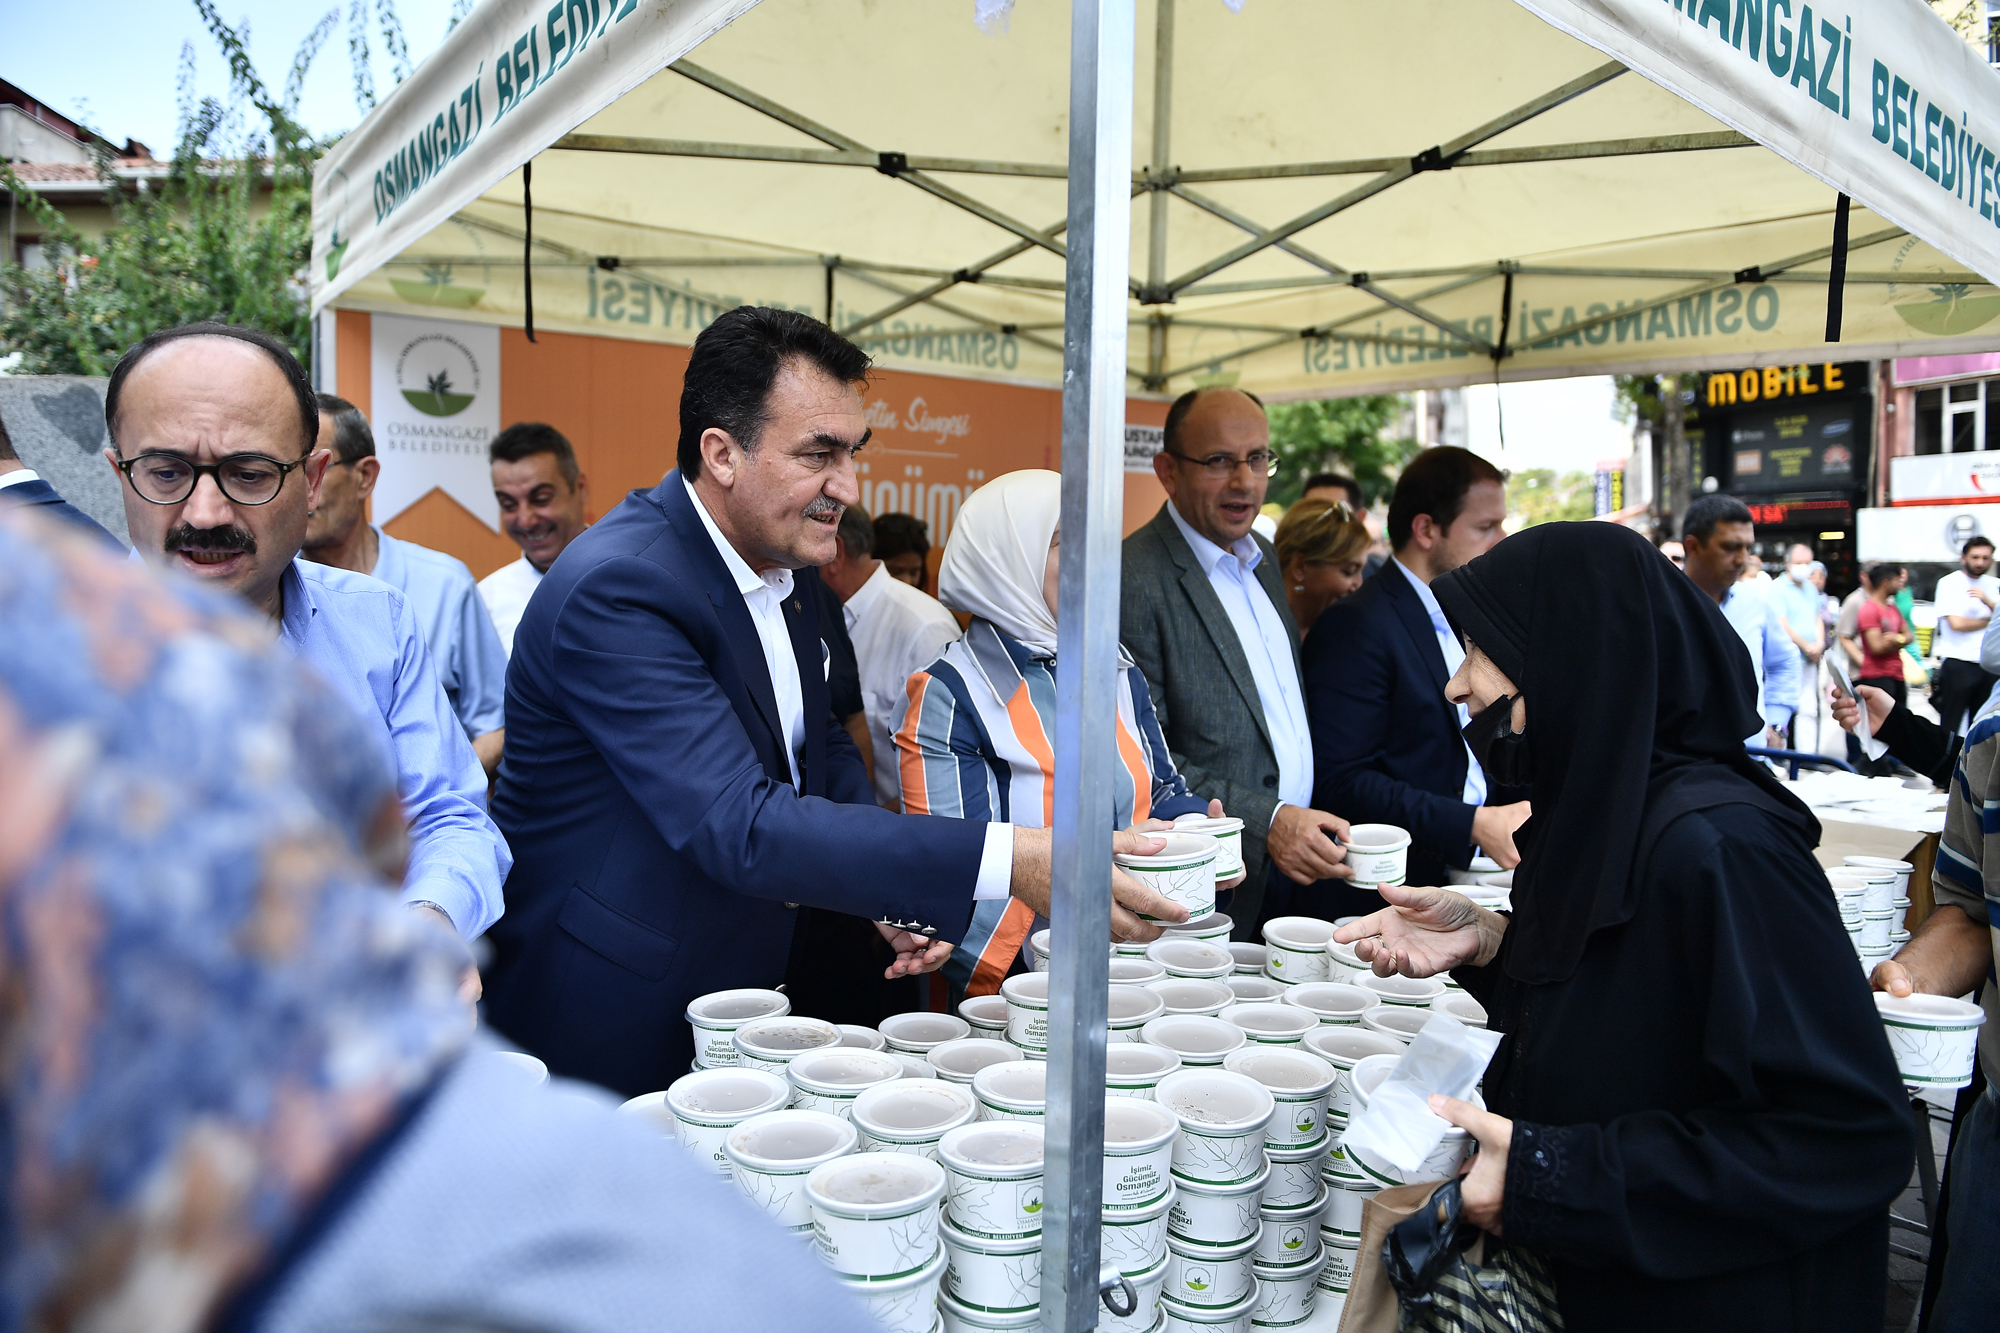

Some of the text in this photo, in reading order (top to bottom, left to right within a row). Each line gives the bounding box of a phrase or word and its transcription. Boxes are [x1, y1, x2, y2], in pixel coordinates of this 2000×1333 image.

[373, 60, 484, 226] OSMANGAZİ
[904, 396, 970, 443] Simgesi
[704, 1050, 740, 1060] Osmangaz
[1130, 1164, 1153, 1175] İşimiz
[1116, 1174, 1161, 1191] Osmangazi
[1122, 1171, 1157, 1183] Gücümüz
